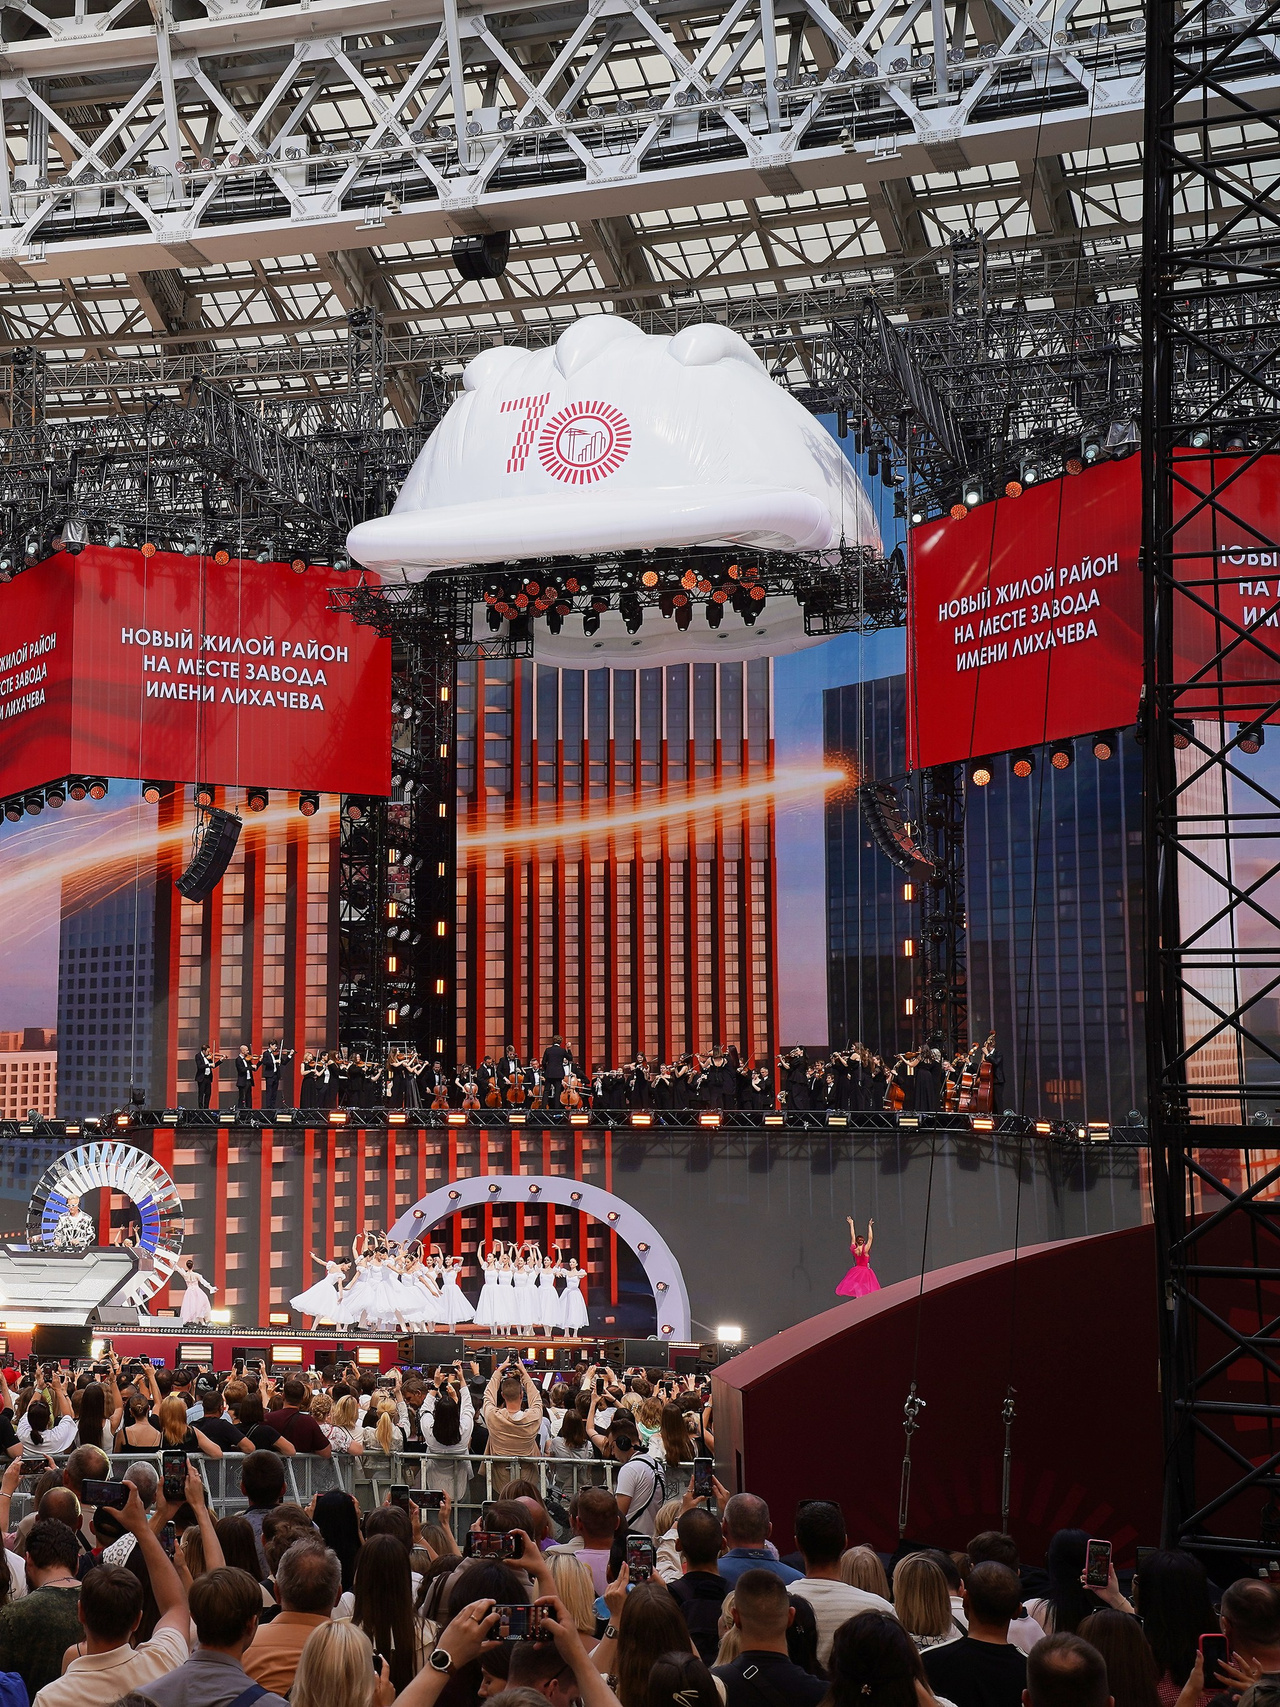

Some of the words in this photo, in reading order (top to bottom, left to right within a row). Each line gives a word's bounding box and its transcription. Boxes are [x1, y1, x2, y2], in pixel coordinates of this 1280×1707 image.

[938, 587, 991, 622] НОВЫЙ
[995, 566, 1054, 606] ЖИЛОЙ
[1060, 552, 1118, 587] РАЙОН
[954, 623, 975, 645] НА
[978, 608, 1026, 638] МЕСТЕ
[1031, 588, 1101, 624] ЗАВОДА
[0, 642, 28, 673] ЖИЛОЙ
[29, 632, 57, 660] РАЙОН
[121, 627, 193, 650] НОВЫЙ
[200, 635, 274, 657] ЖИЛОЙ
[281, 639, 349, 663] РАЙОН
[956, 641, 1008, 672] ИМЕНИ
[1012, 618, 1098, 658] ЛИХАЧЕВА
[14, 662, 48, 690] ЗАВОДА
[143, 655, 171, 673] НА
[177, 658, 240, 679] МЕСТЕ
[245, 663, 328, 687] ЗАВОДА
[4, 688, 46, 719] ЛИХАЧЕВА
[146, 681, 215, 702] ИМЕНИ
[220, 687, 325, 711] ЛИХАЧЕВА
